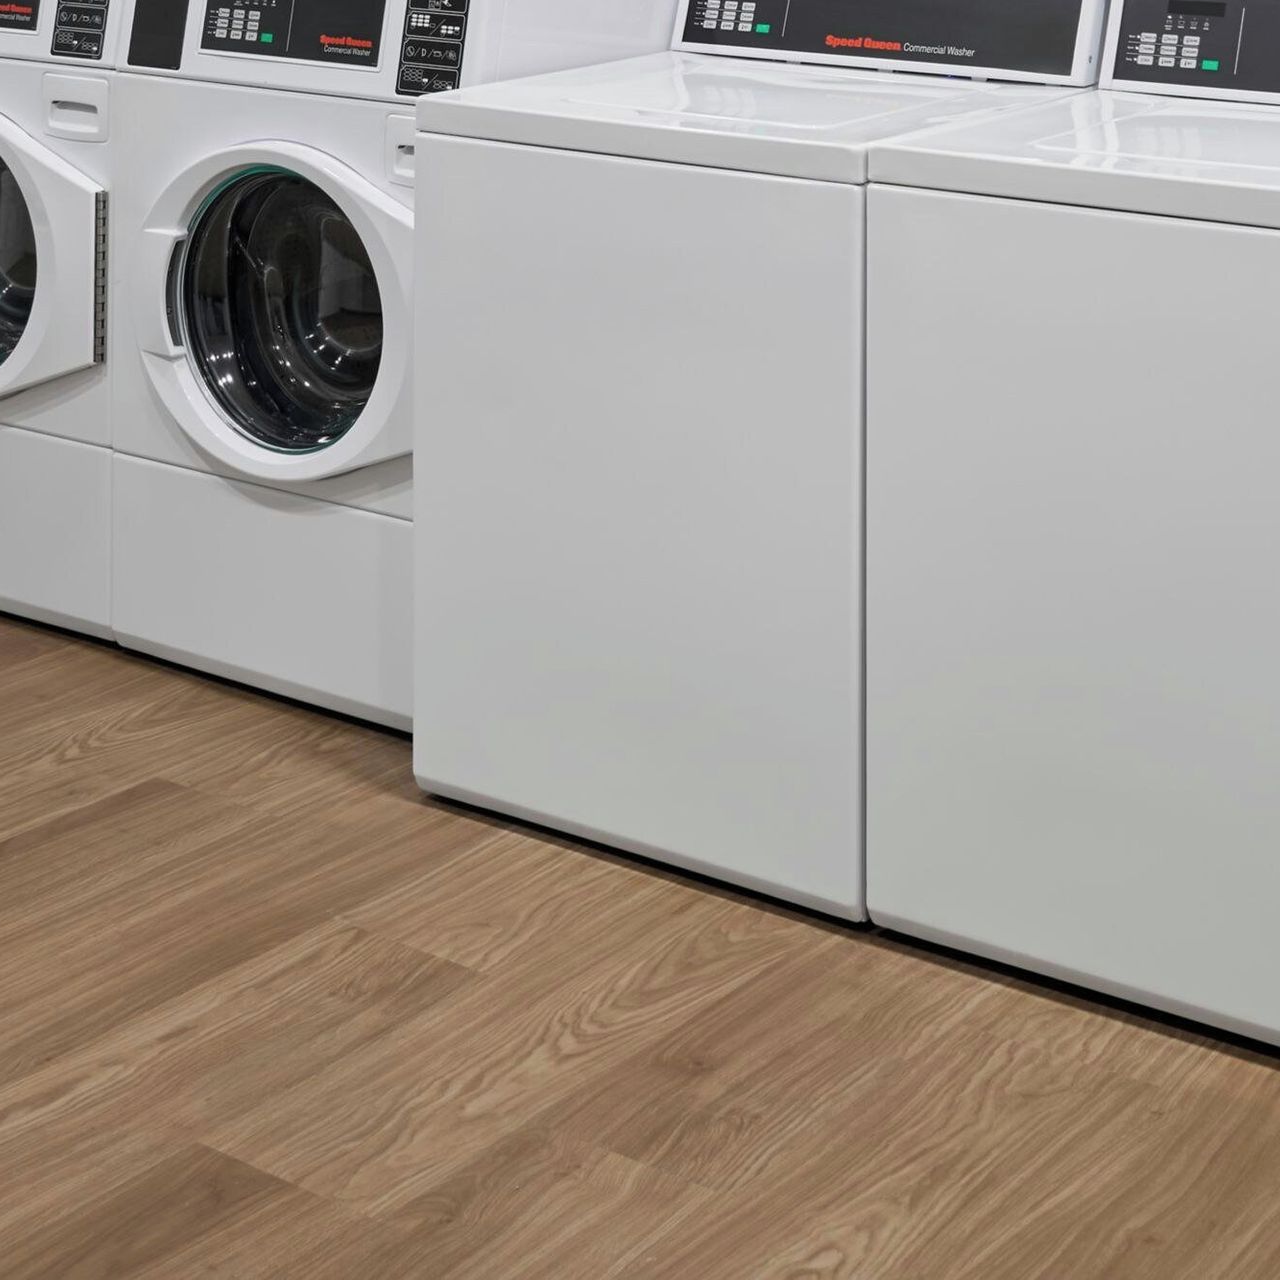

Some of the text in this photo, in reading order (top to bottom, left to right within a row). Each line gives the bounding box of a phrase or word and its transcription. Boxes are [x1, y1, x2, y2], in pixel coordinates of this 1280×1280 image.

[320, 34, 345, 47] Speed
[825, 35, 975, 57] Speed Queen Commercial Washer
[323, 46, 351, 55] Commercial
